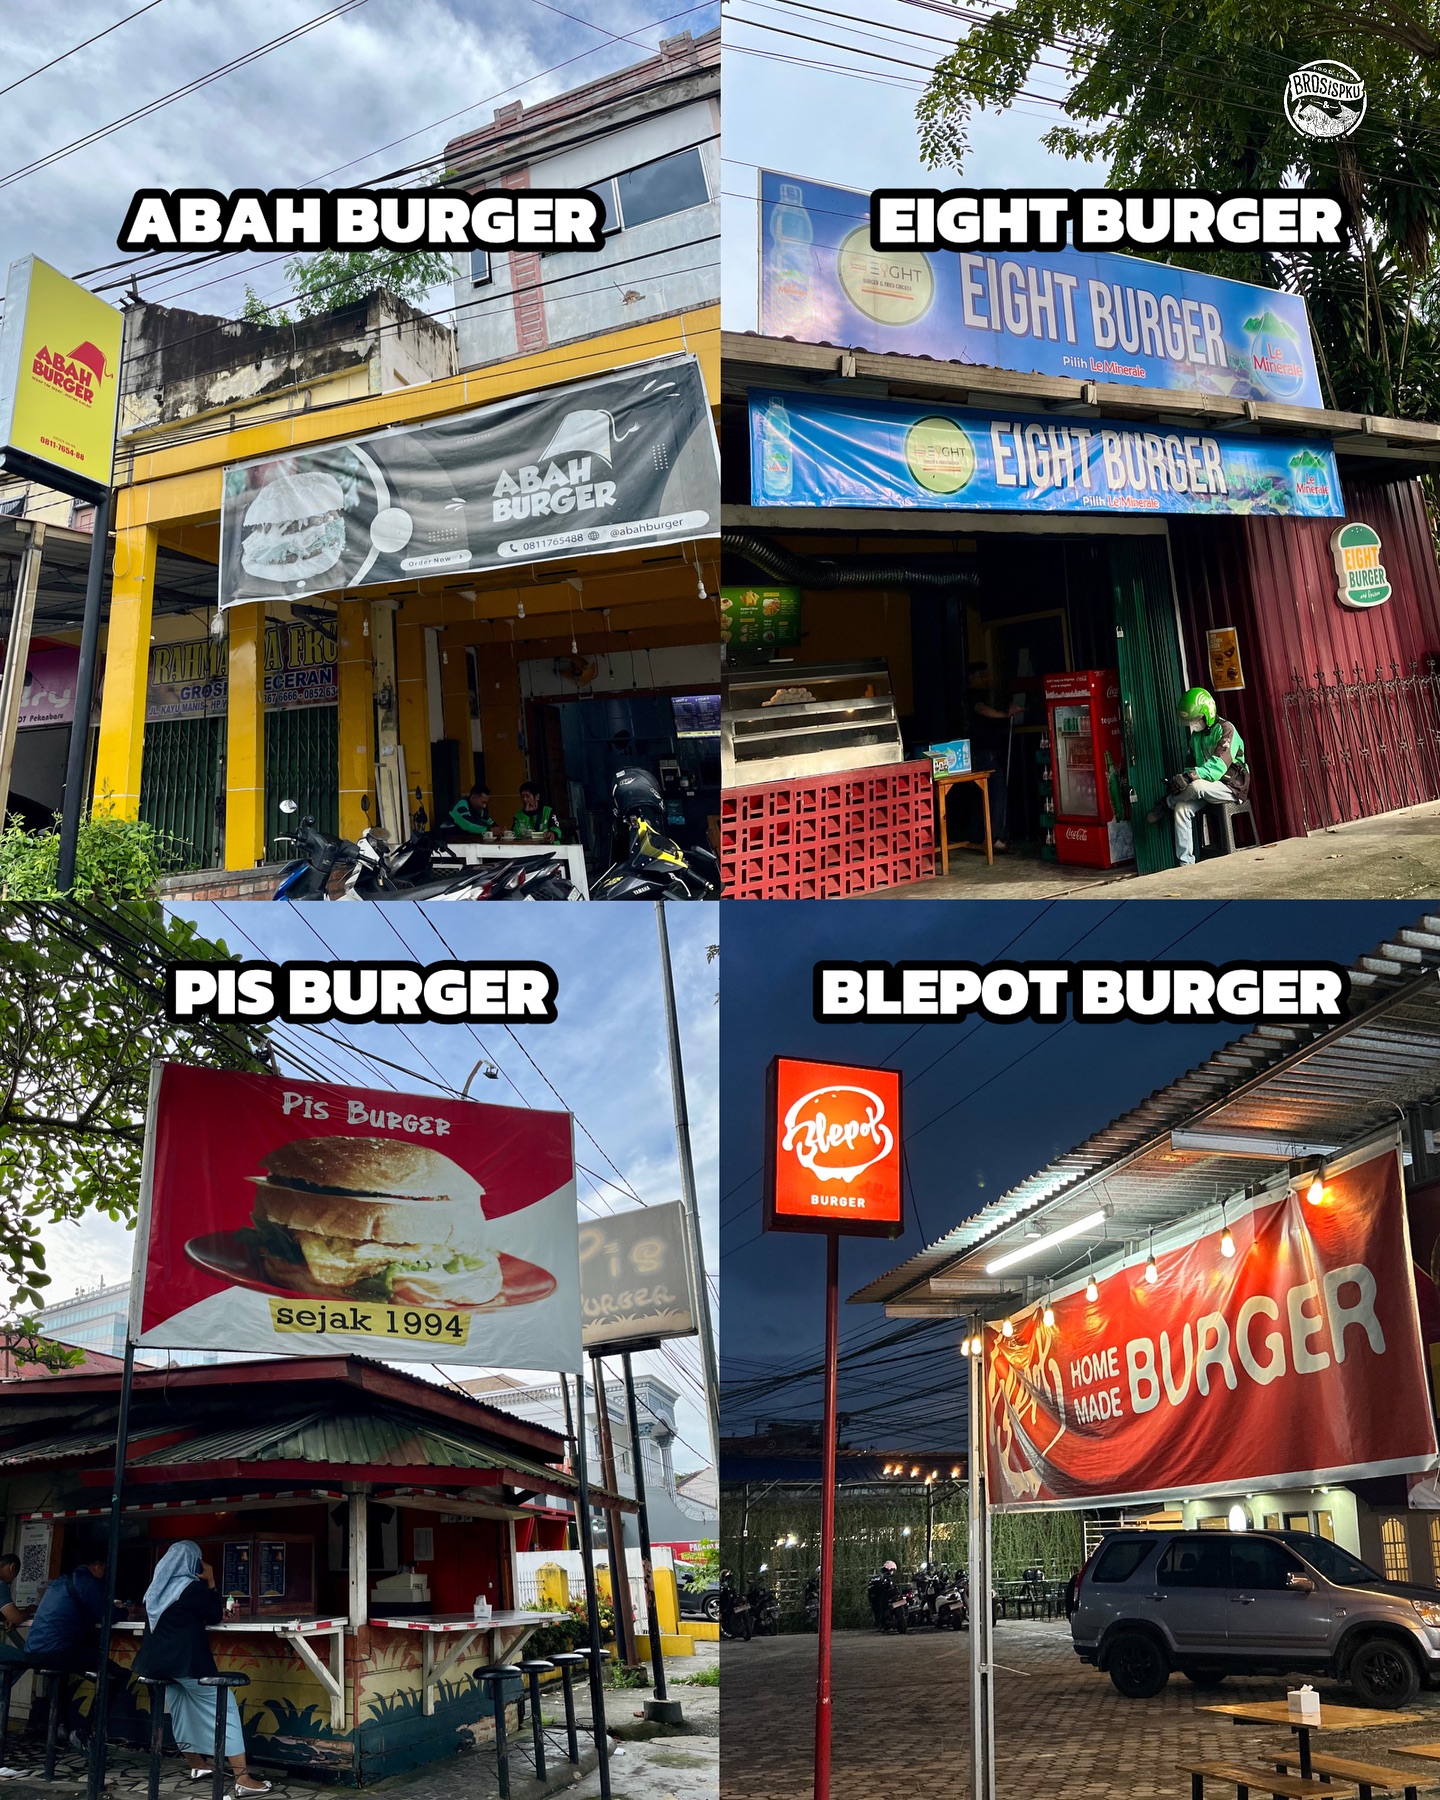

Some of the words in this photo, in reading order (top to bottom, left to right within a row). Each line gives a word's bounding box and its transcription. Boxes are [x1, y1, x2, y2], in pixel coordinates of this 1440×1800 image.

[959, 252, 1078, 344] EIGHT
[1088, 278, 1229, 370] BURGER
[35, 345, 92, 387] ABAH
[1253, 354, 1304, 378] Minerale
[1267, 343, 1282, 361] Le
[32, 358, 94, 405] BURGER
[1063, 355, 1088, 369] Pilih
[1090, 356, 1104, 373] Le
[1104, 359, 1146, 380] Minerale
[989, 420, 1093, 488] EIGHT
[1102, 428, 1230, 495] BURGER
[493, 455, 592, 498] ABAH
[1296, 482, 1329, 494] Minerale
[1306, 473, 1315, 485] Le
[493, 480, 618, 523] BURGER
[1082, 495, 1106, 507] Pilih
[1107, 495, 1120, 508] Le
[1121, 495, 1159, 509] Minerale
[523, 533, 585, 552] 0811765488
[610, 516, 685, 540] @abahburger
[408, 557, 431, 568] Order
[433, 555, 452, 566] Now
[1344, 546, 1378, 571] EIGHT
[1349, 568, 1386, 589] BURGER
[304, 687, 324, 699] 0852
[29, 713, 64, 722] Pekanbaru
[811, 1194, 866, 1208] BURGER
[581, 1285, 677, 1317] URGER
[277, 1305, 372, 1334] sejak
[387, 1310, 464, 1338] 1994
[1125, 1263, 1386, 1414] BURGER
[1070, 1346, 1120, 1388] HOME
[1074, 1387, 1123, 1426] MADE
